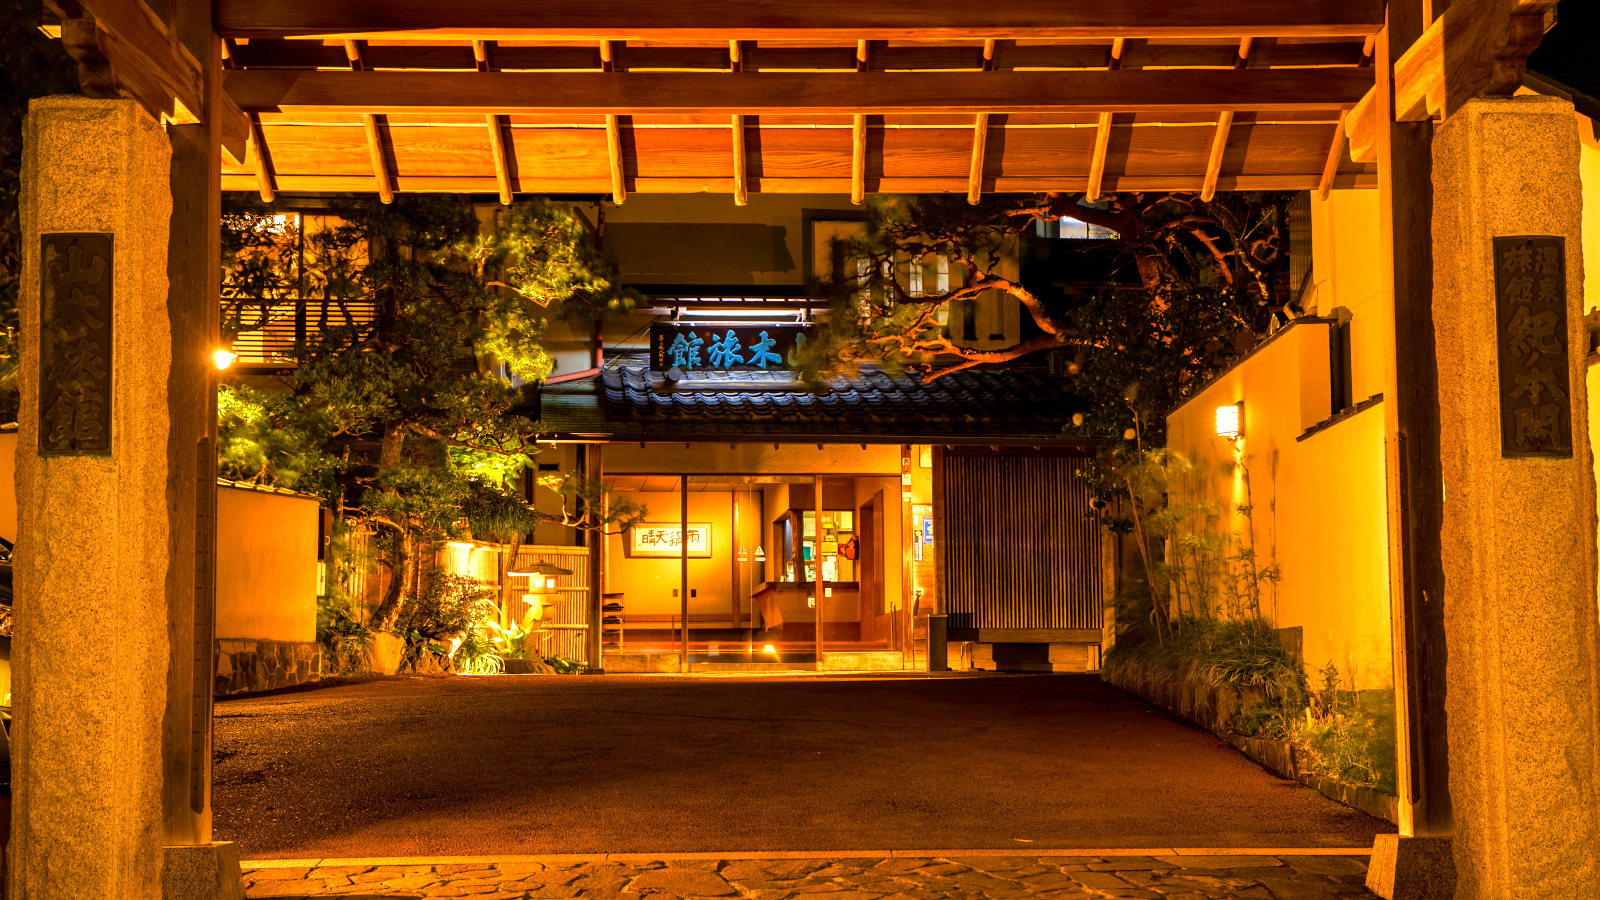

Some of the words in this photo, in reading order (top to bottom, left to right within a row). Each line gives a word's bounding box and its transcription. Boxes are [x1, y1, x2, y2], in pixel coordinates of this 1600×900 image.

[1501, 244, 1535, 304] 旅館
[1534, 246, 1560, 303] 温泉
[46, 245, 107, 443] 山木旅館
